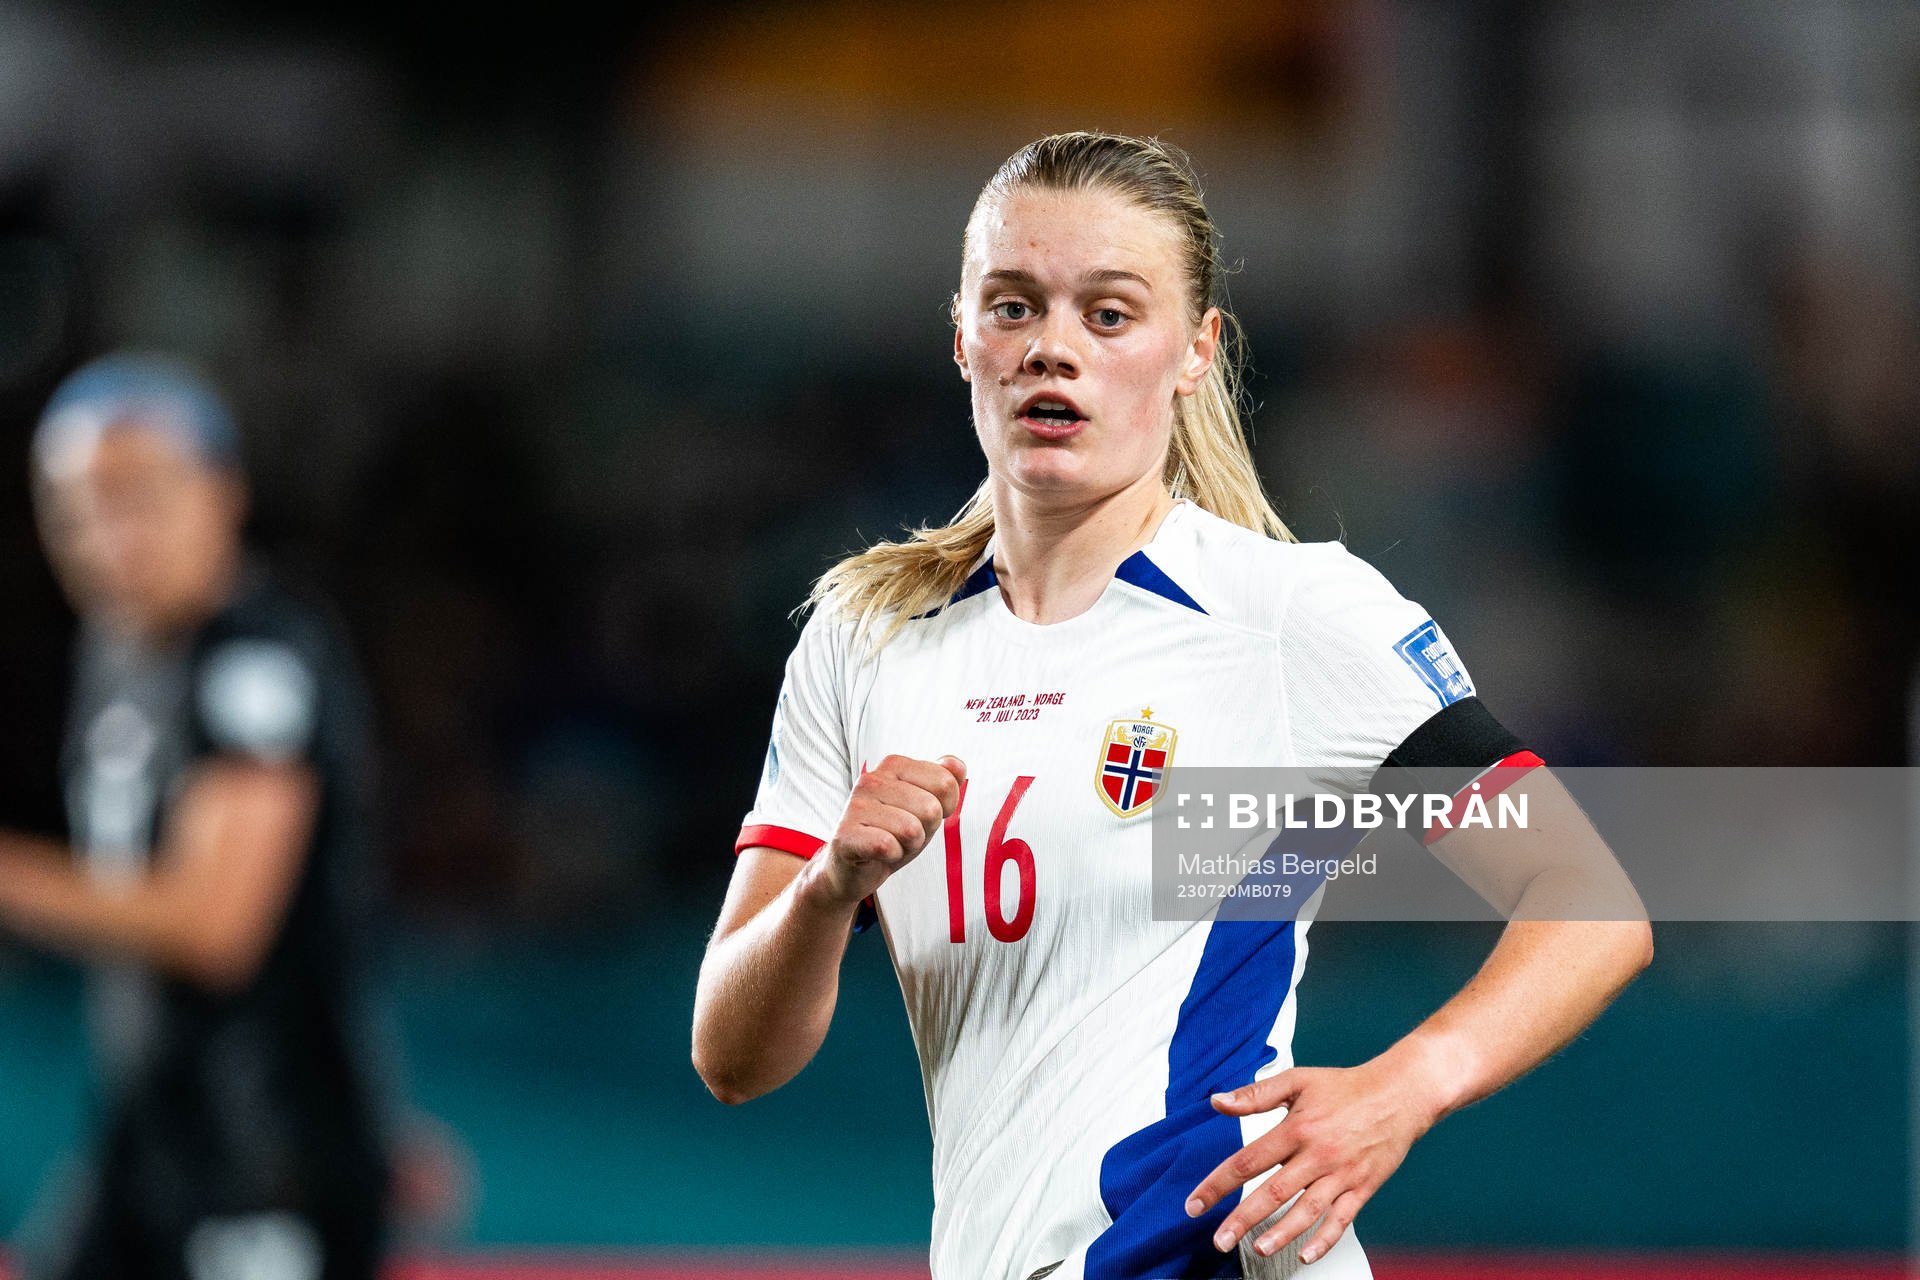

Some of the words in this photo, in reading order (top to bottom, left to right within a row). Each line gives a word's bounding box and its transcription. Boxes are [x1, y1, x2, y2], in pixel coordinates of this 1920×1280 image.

[964, 698, 986, 710] NEW
[986, 694, 1025, 709] ZEALAND
[1033, 692, 1066, 706] NORGE
[976, 711, 991, 722] 20.
[993, 709, 1015, 723] JULI
[1015, 708, 1040, 721] 2023
[1132, 724, 1154, 735] NORGE
[944, 775, 1037, 944] 16
